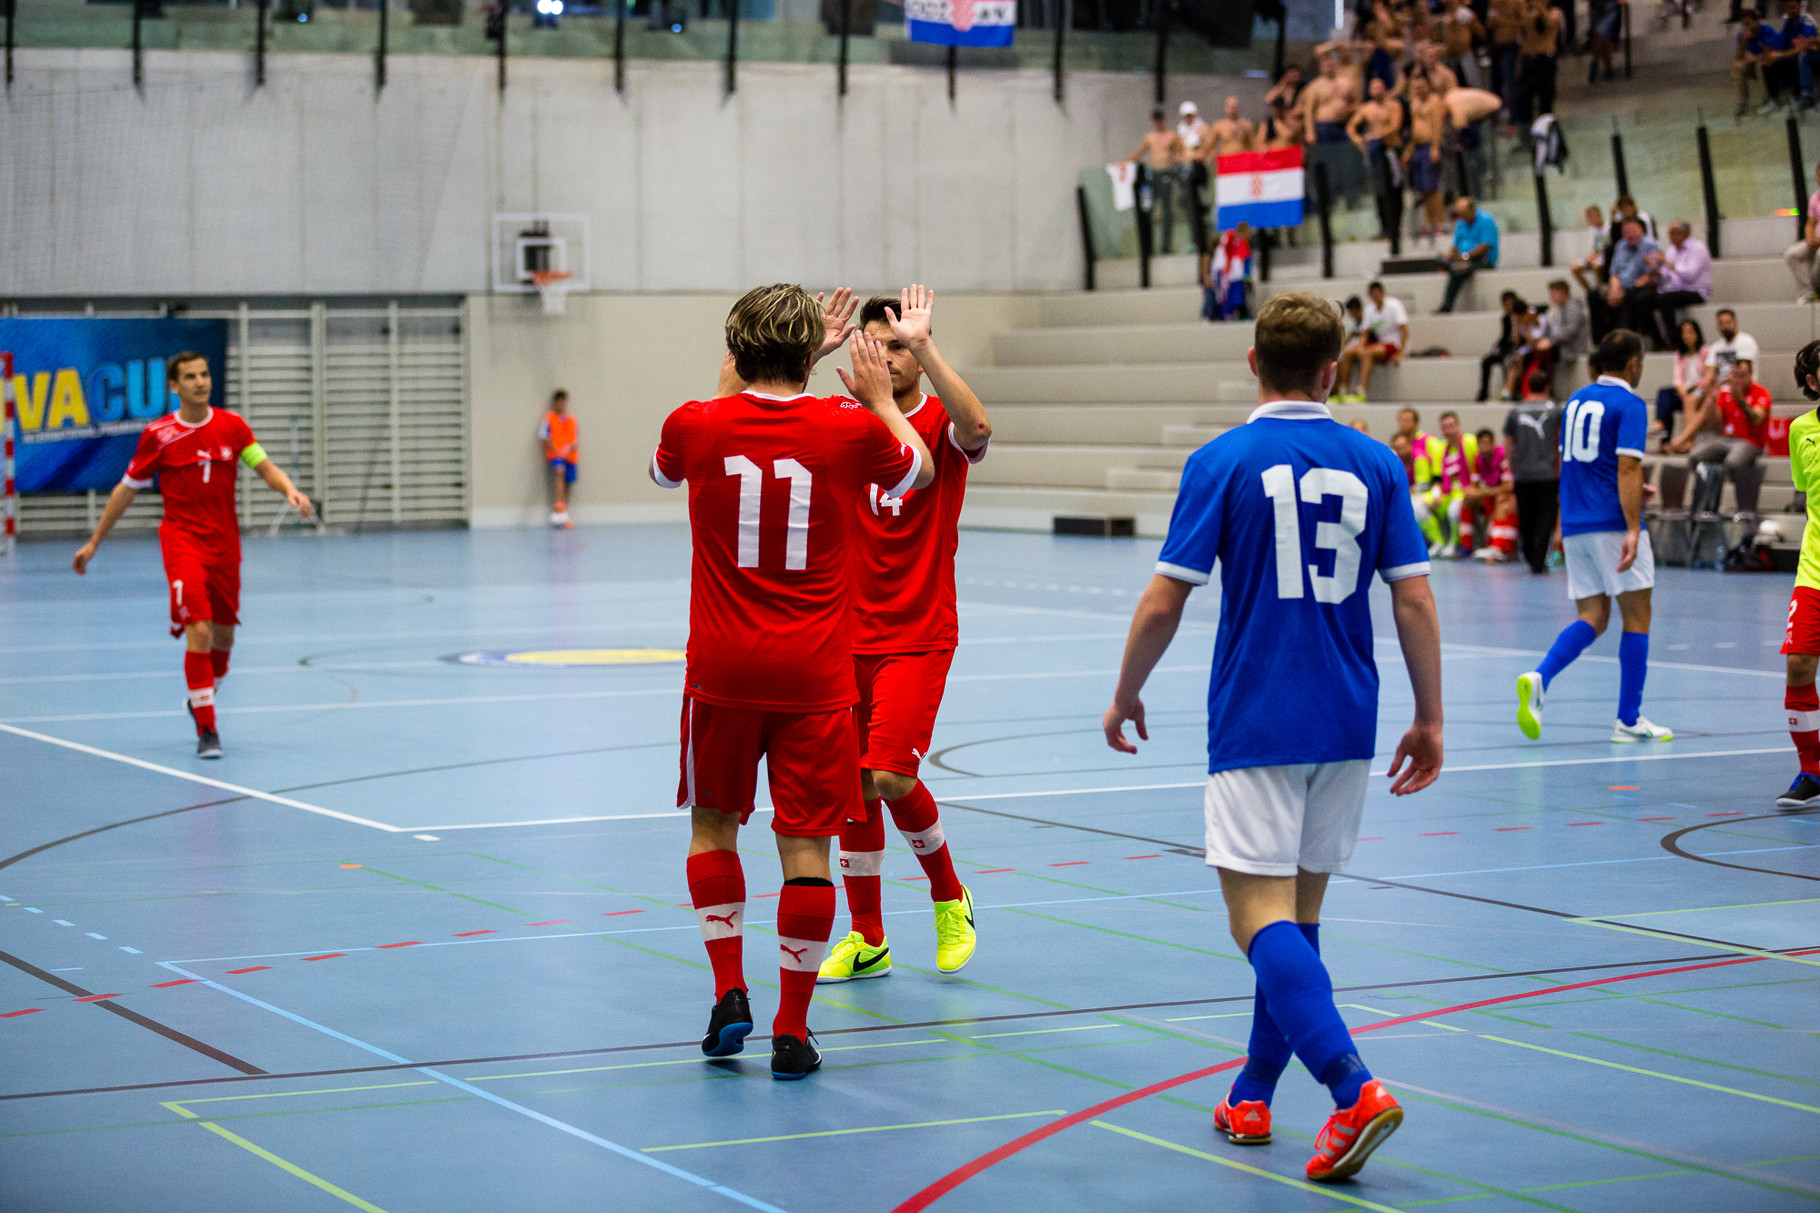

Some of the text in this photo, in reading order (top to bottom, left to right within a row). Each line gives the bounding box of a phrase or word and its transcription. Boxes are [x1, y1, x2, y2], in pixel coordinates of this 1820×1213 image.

[1563, 399, 1605, 463] 10
[197, 460, 211, 483] 7
[870, 483, 903, 516] 14
[724, 455, 812, 570] 11
[1261, 464, 1368, 604] 13
